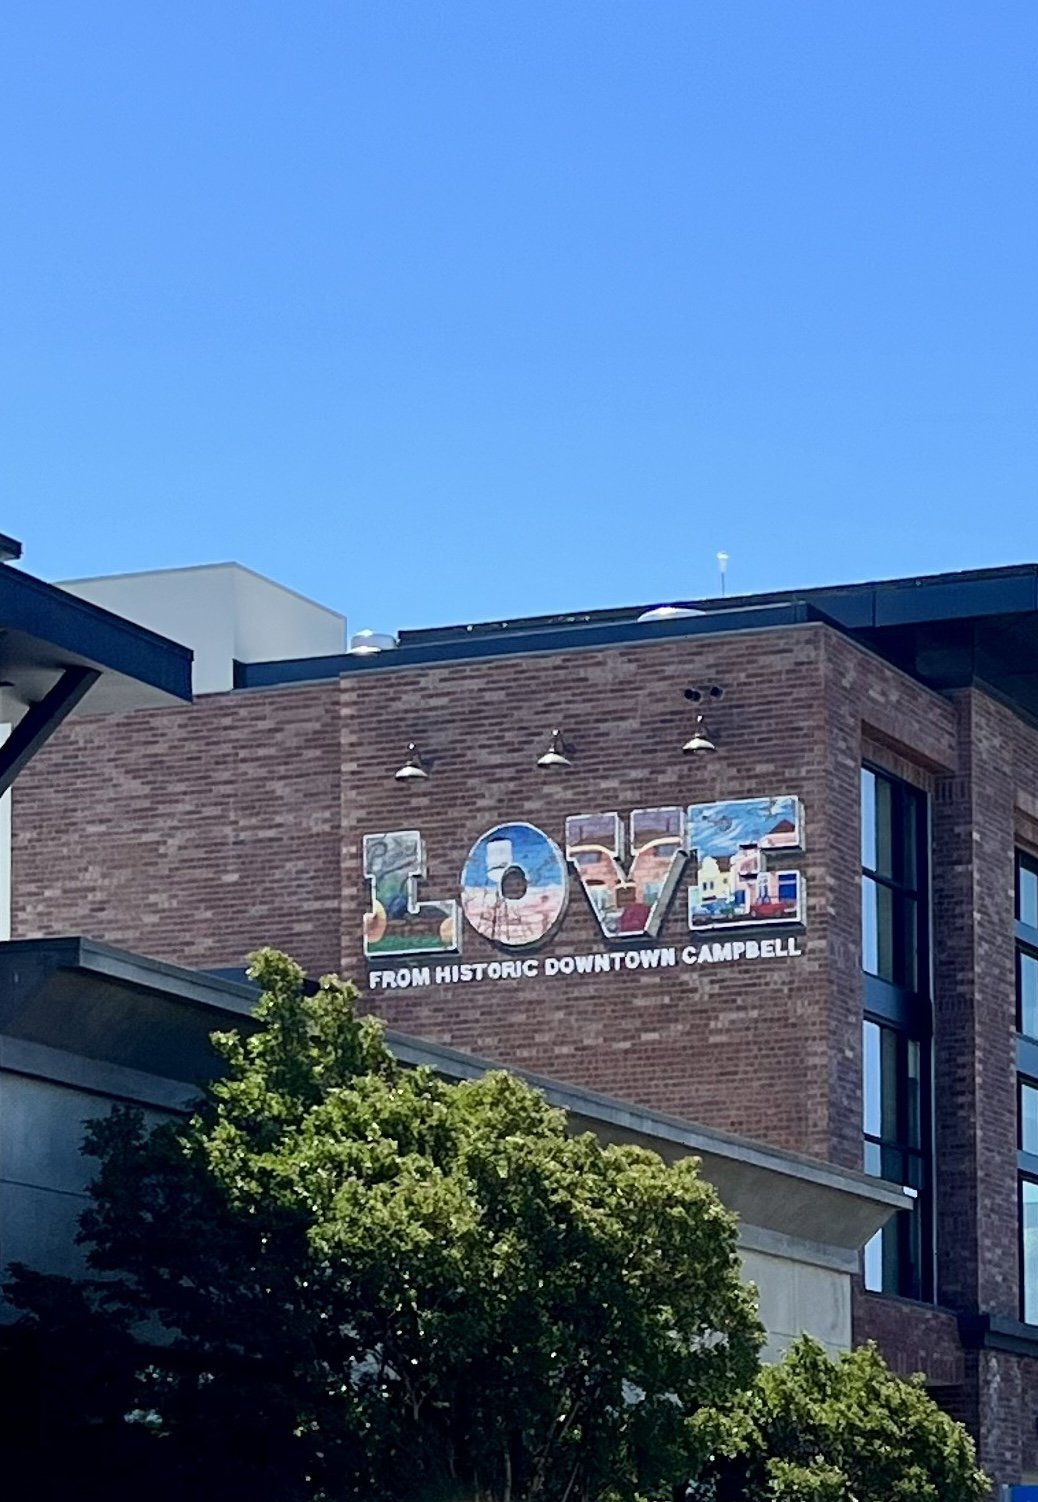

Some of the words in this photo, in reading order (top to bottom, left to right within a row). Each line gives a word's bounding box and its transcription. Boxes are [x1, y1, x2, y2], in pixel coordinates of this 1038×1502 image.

[362, 795, 806, 959] LOVE
[369, 967, 430, 989] FROM
[435, 959, 537, 984] HISTORIC
[544, 947, 676, 976] DOWNTOWN
[682, 937, 802, 965] CAMPBELL
